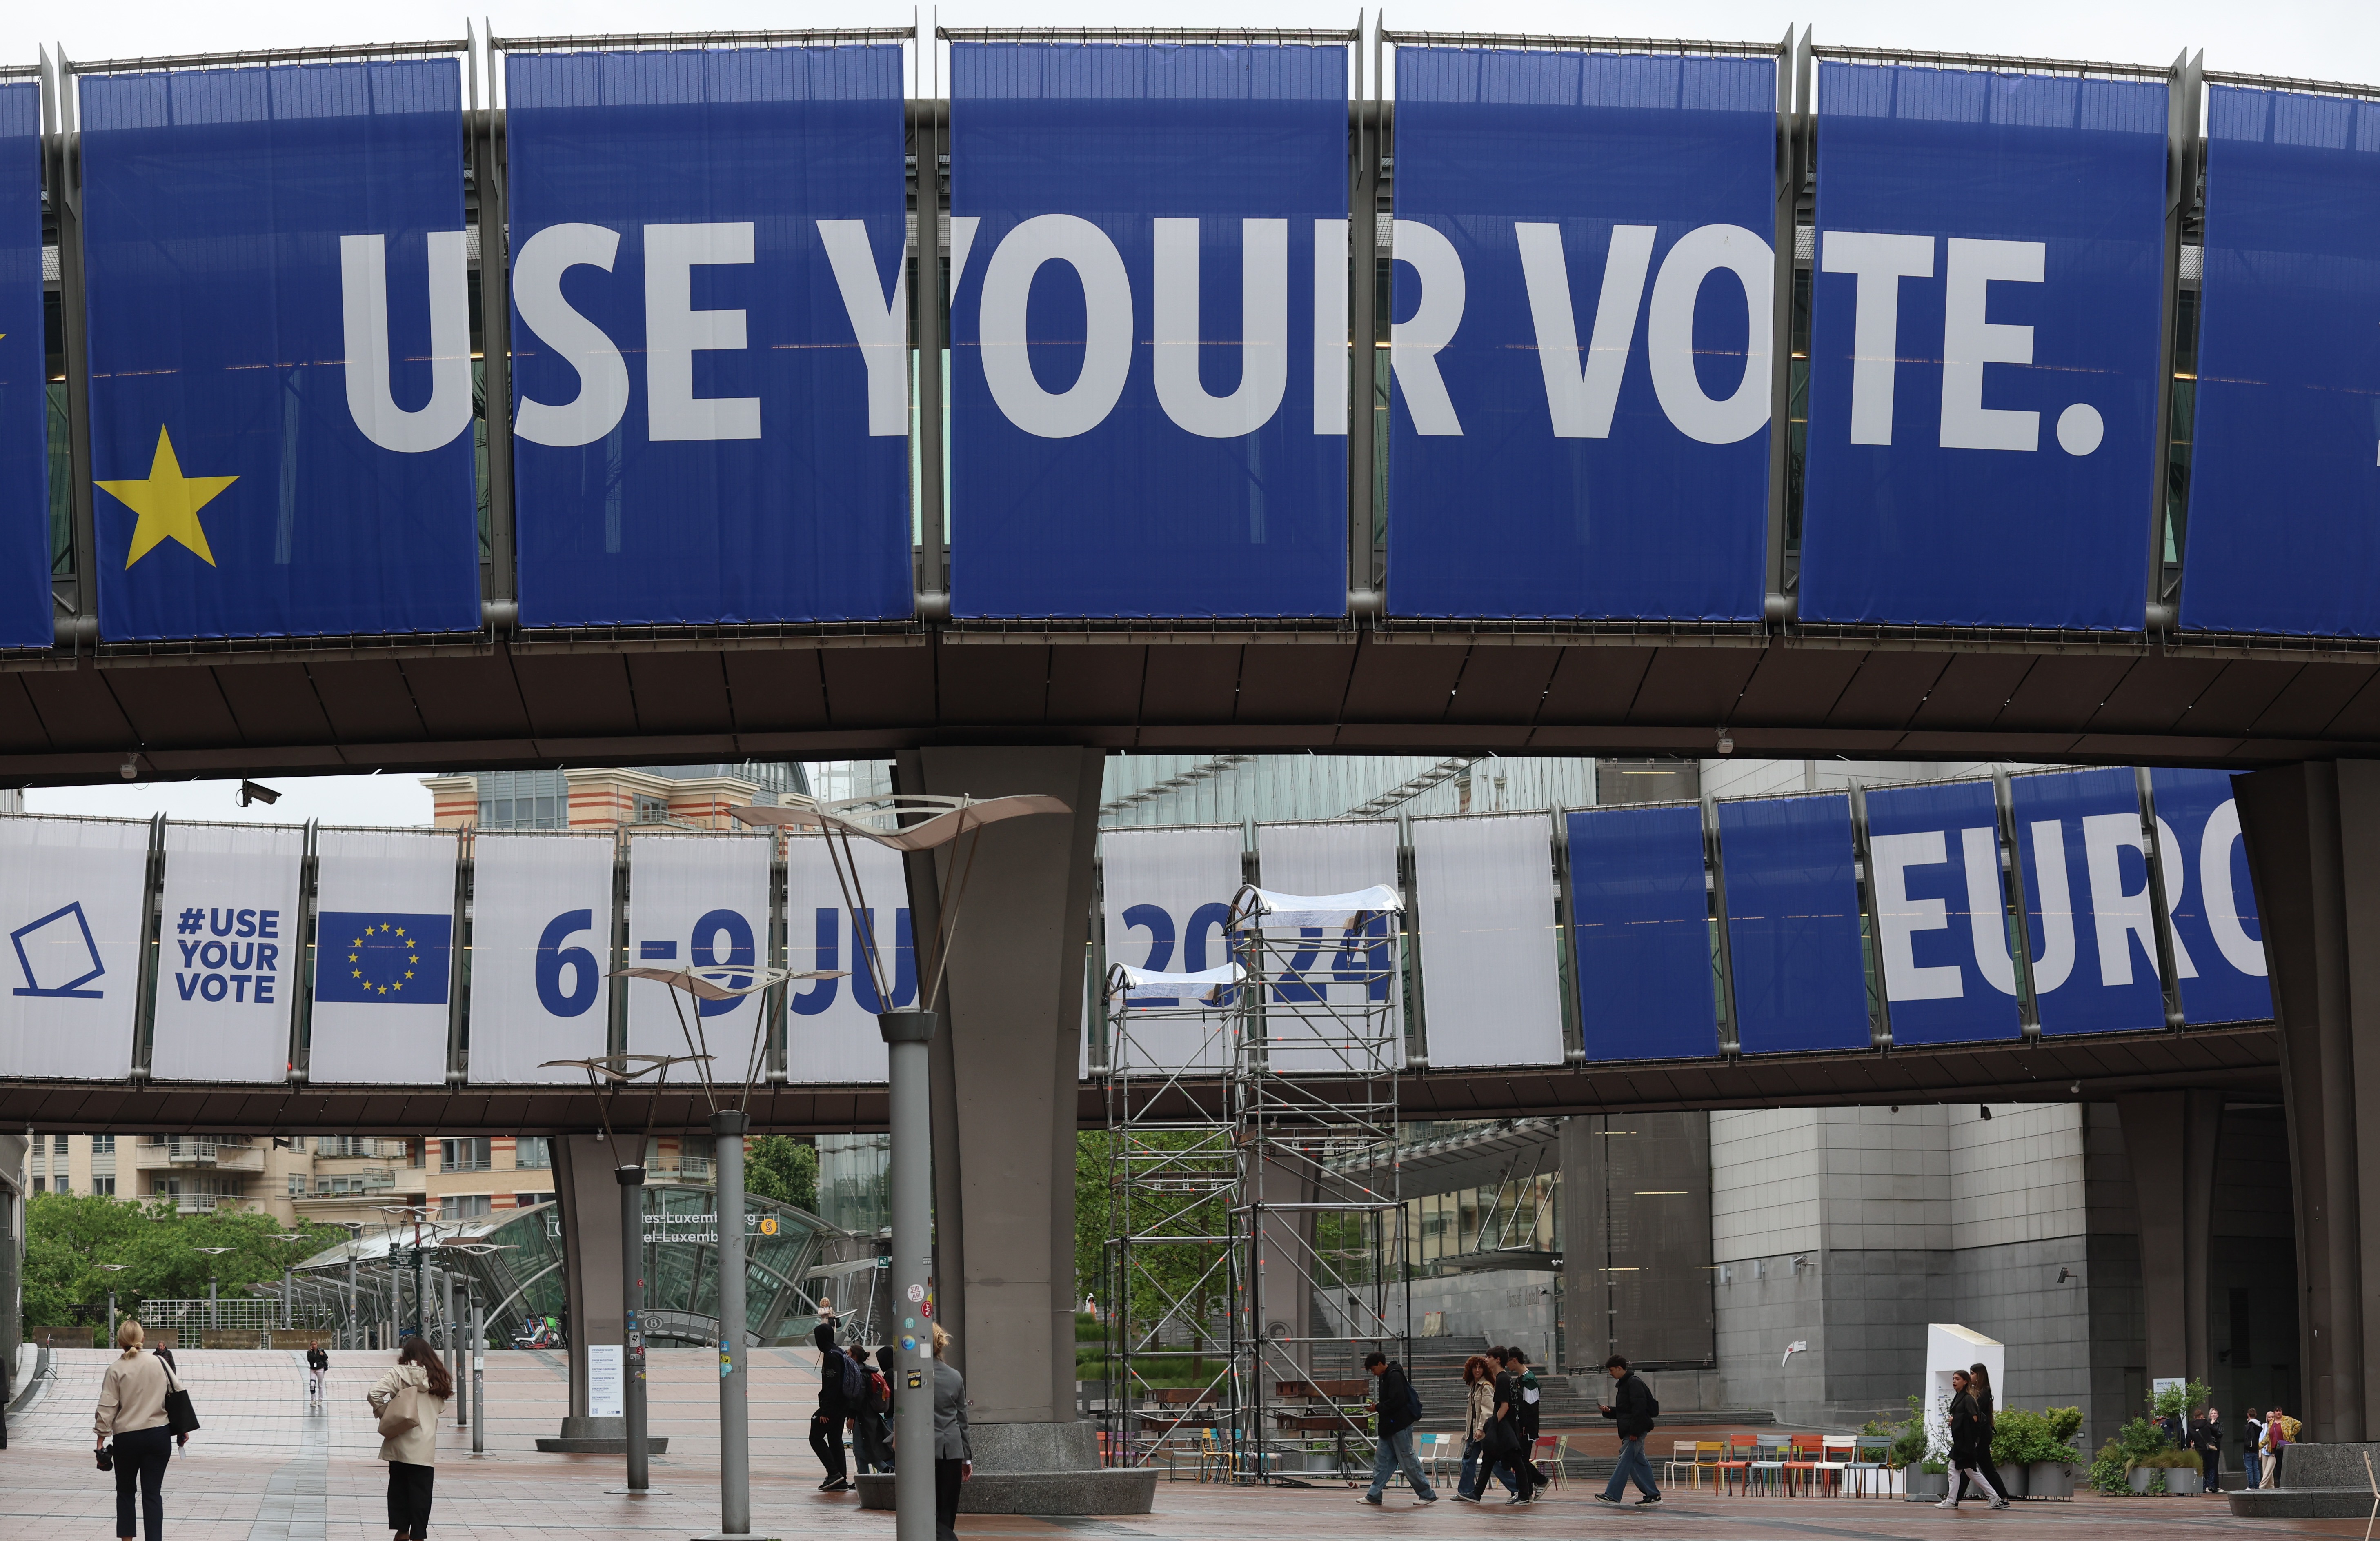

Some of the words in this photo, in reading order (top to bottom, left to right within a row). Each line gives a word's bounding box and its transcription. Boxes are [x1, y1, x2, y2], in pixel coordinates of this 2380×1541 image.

[340, 222, 761, 453] USE
[816, 214, 1466, 438] YOUR
[1514, 223, 2104, 456] VOTE.
[177, 908, 279, 939] #USE
[178, 940, 278, 971] YOUR
[790, 908, 917, 1016] JU
[175, 972, 275, 1004] VOTE
[912, 1291, 921, 1300] ART
[650, 1319, 658, 1328] B
